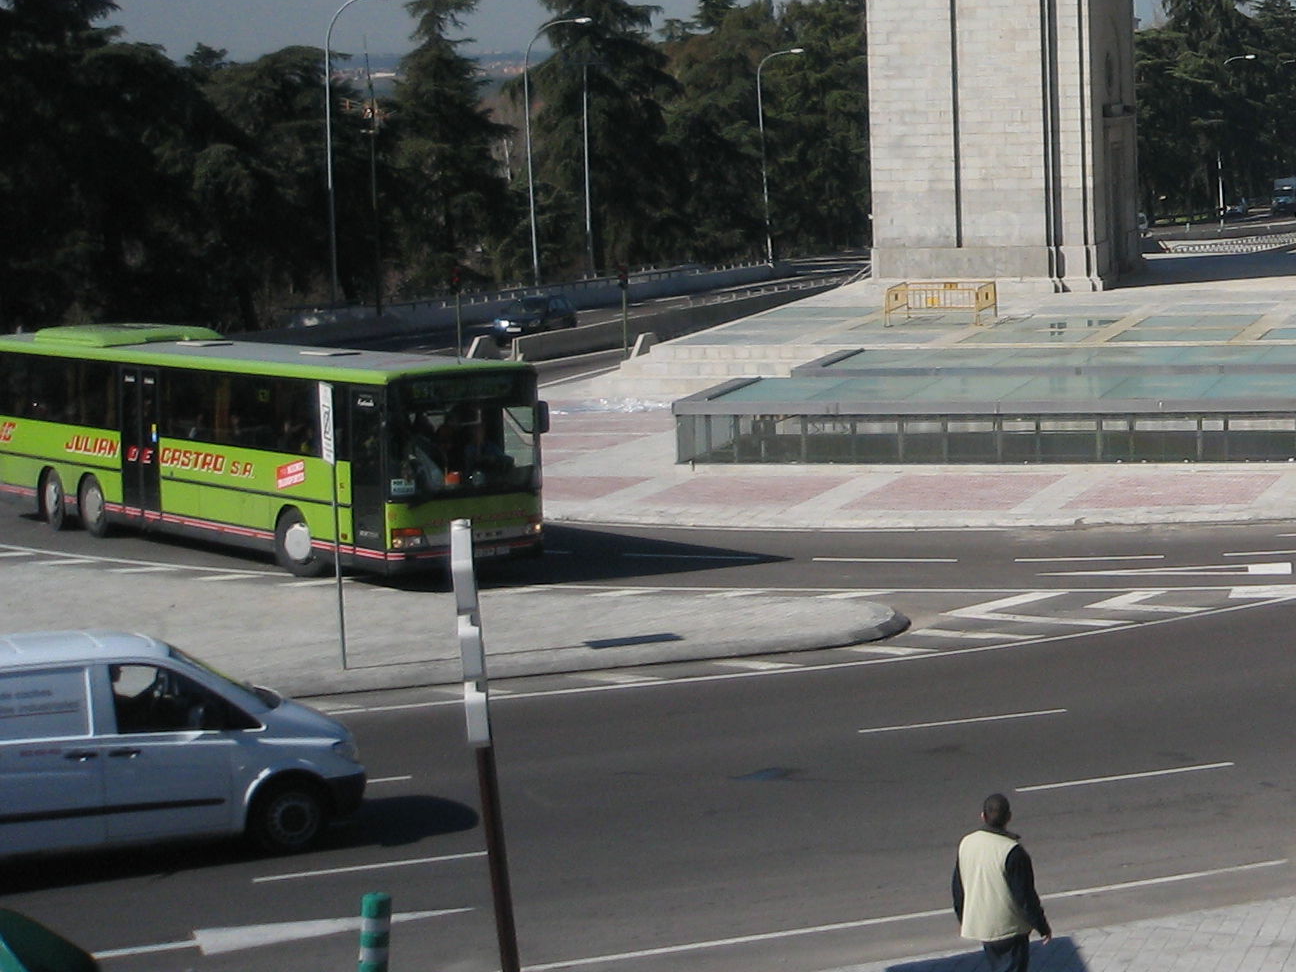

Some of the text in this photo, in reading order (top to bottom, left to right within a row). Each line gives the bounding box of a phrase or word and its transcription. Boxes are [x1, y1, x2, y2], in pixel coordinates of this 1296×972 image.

[65, 434, 121, 458] JULIAN
[126, 444, 154, 464] DE
[159, 446, 227, 475] CASTRO
